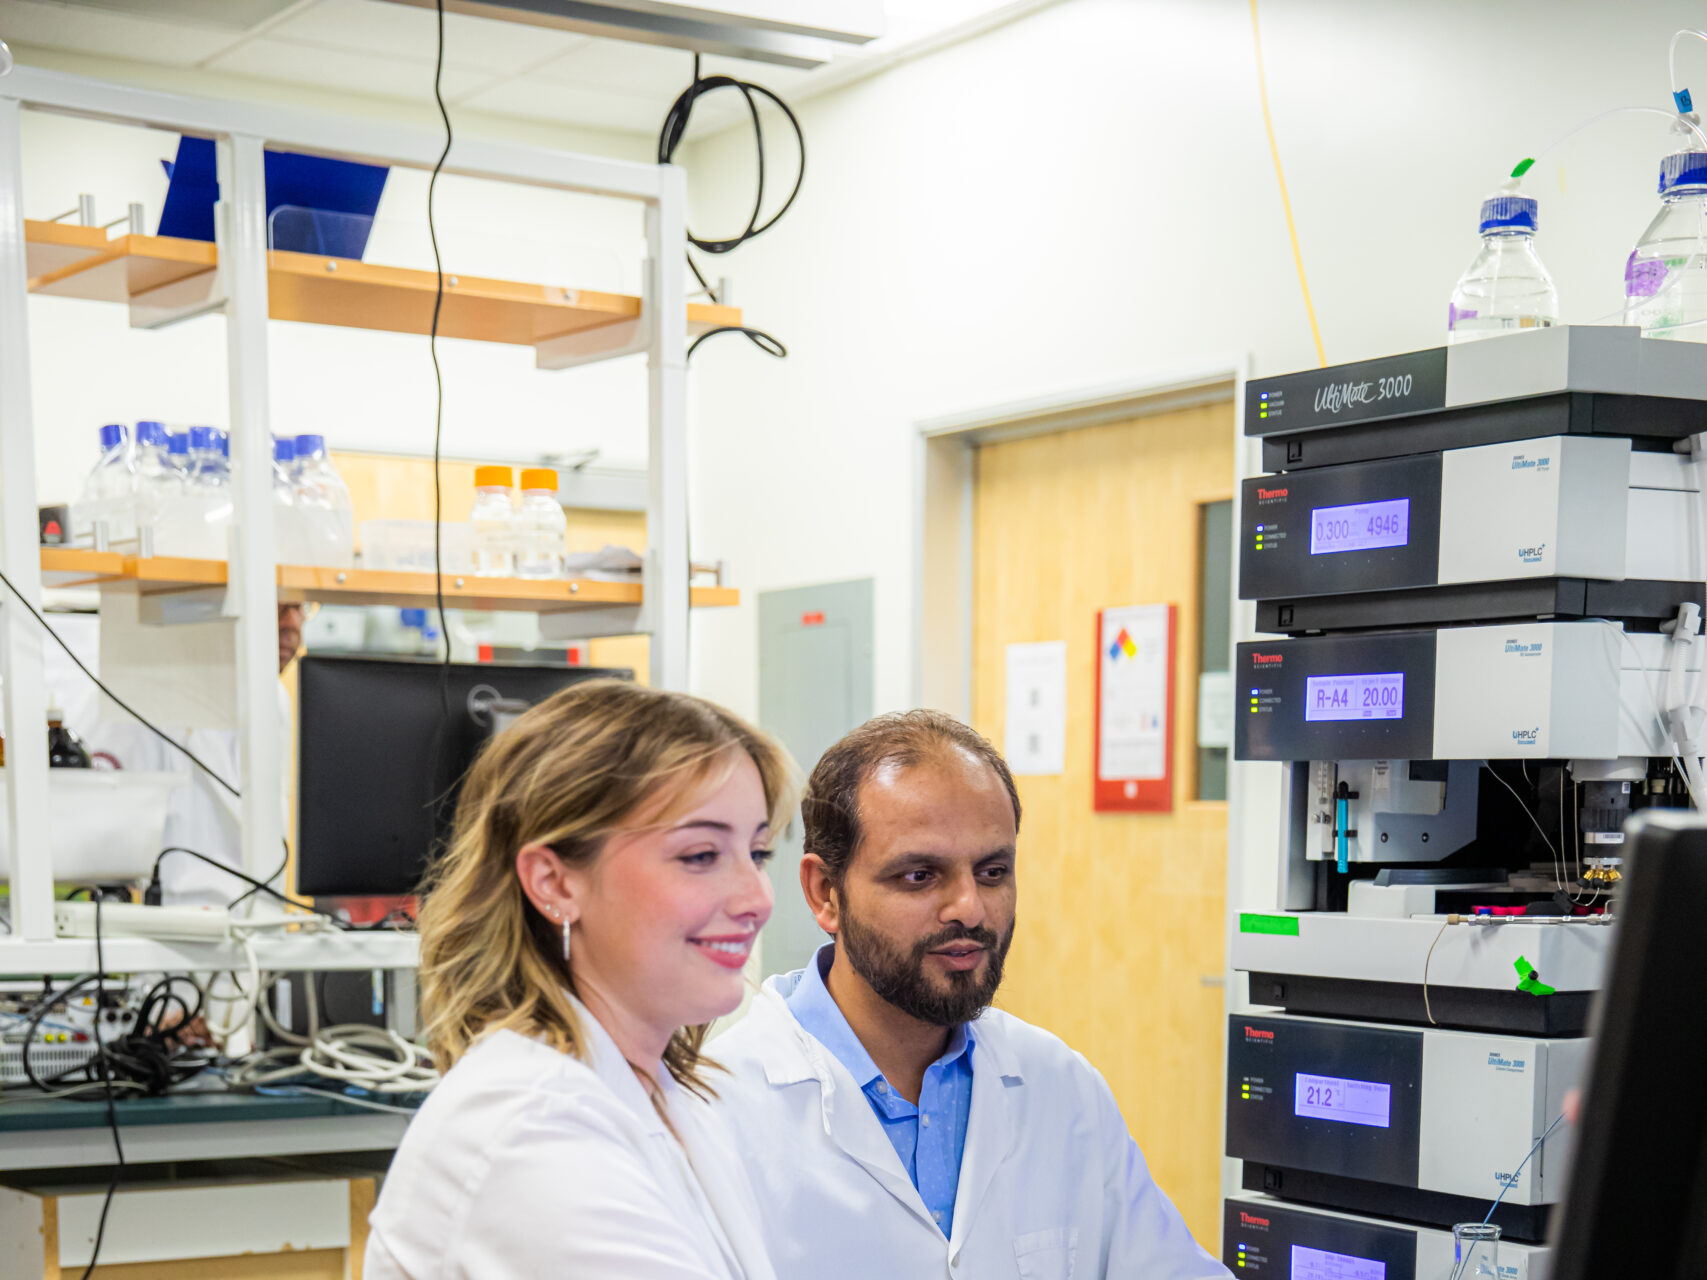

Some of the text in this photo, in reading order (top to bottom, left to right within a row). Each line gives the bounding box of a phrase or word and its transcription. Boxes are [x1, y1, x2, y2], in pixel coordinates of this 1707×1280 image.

[1314, 373, 1412, 413] UltiMate 3000
[1257, 488, 1288, 499] Thermo
[1315, 514, 1399, 541] 0.300 4946
[1252, 653, 1283, 663] Thermo
[1316, 686, 1398, 708] R-A4 20.00
[1244, 1026, 1275, 1039] Thermo
[1306, 1086, 1333, 1107] 21.2
[1240, 1212, 1270, 1226] Thermo
